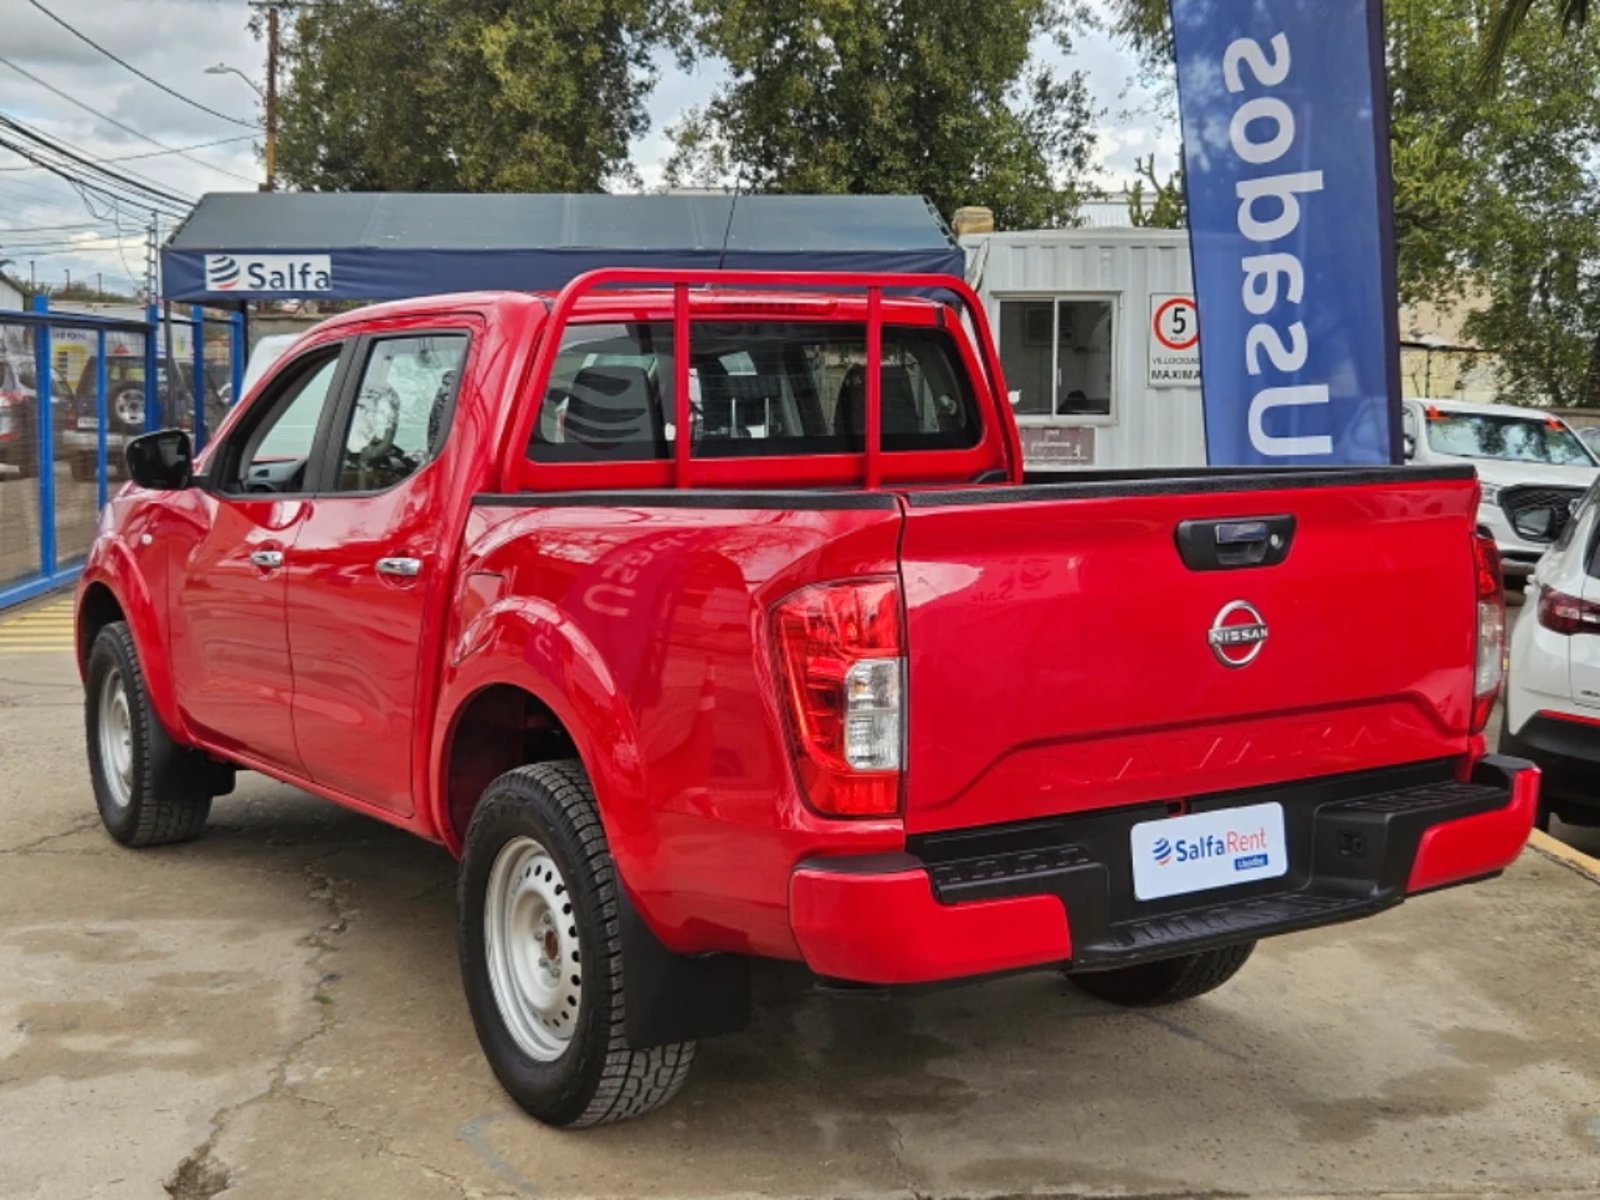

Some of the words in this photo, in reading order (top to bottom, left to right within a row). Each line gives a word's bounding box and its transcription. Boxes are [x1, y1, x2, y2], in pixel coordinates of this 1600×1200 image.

[247, 262, 330, 289] Salfa
[1171, 307, 1187, 334] 5
[1210, 627, 1268, 642] NISSAN
